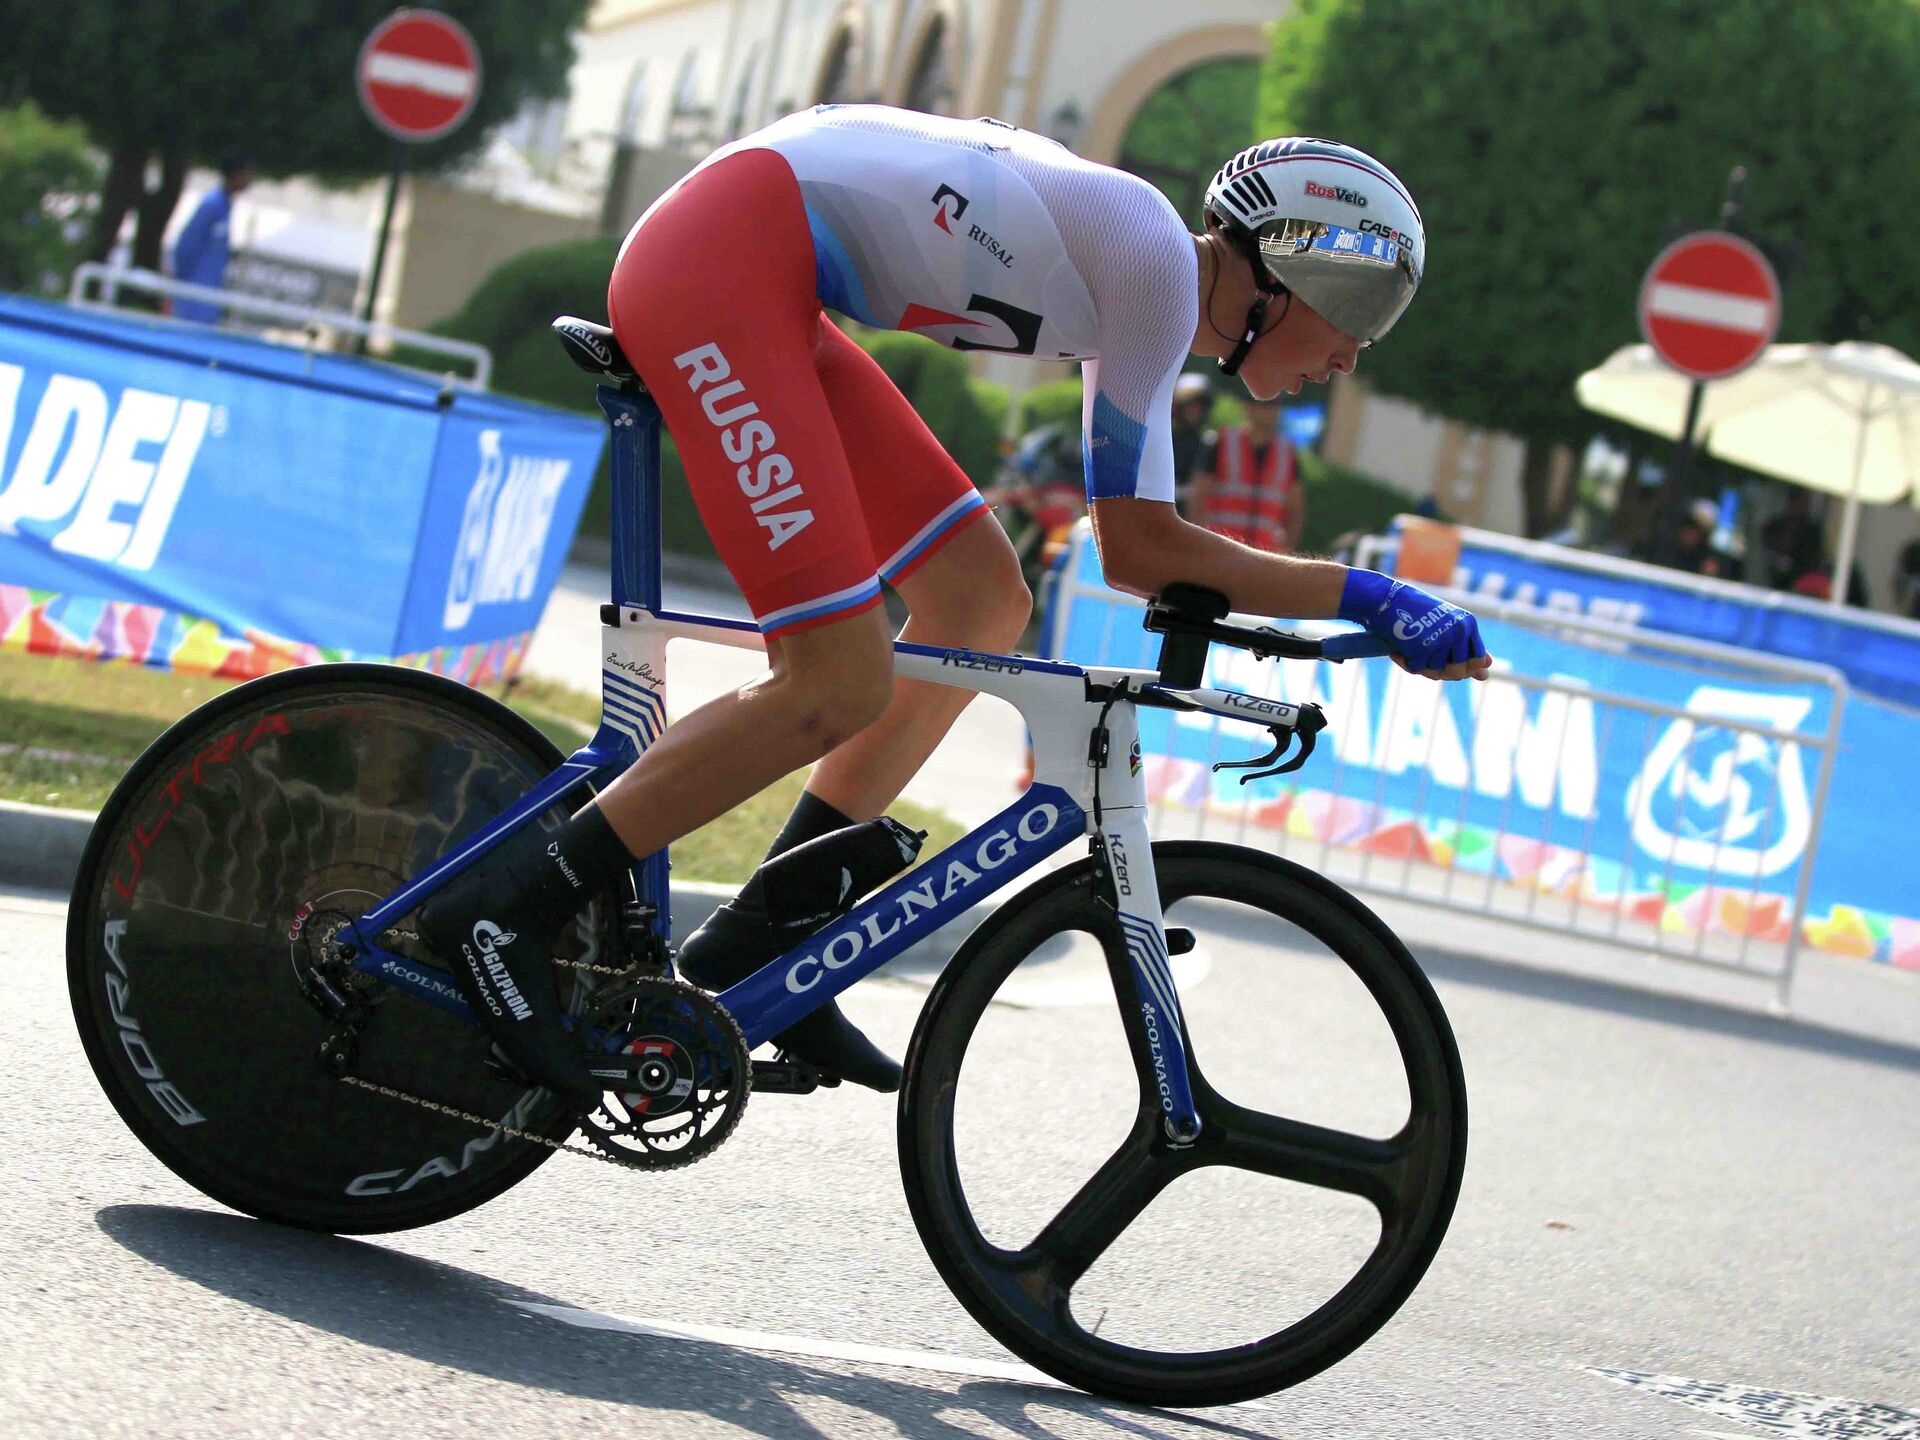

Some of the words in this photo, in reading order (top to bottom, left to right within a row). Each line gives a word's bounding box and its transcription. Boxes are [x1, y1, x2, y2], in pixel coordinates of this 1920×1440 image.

[1305, 181, 1369, 208] RusVelo
[968, 223, 1014, 269] RUSAL
[1358, 219, 1414, 251] CASCO
[673, 342, 815, 551] RUSSIA
[941, 651, 1024, 675] K.Zero
[1223, 693, 1290, 718] K.Zero
[113, 713, 291, 902] ULTRA
[556, 856, 582, 888] Nalini
[1108, 834, 1131, 896] K.Zero
[785, 803, 1059, 994] COLNAGO
[393, 966, 468, 1004] COLNA
[462, 943, 503, 1017] COLNAGO
[483, 951, 533, 1021] GAZPROM
[104, 919, 208, 1126] BORA
[1145, 1014, 1173, 1112] COLNAGO
